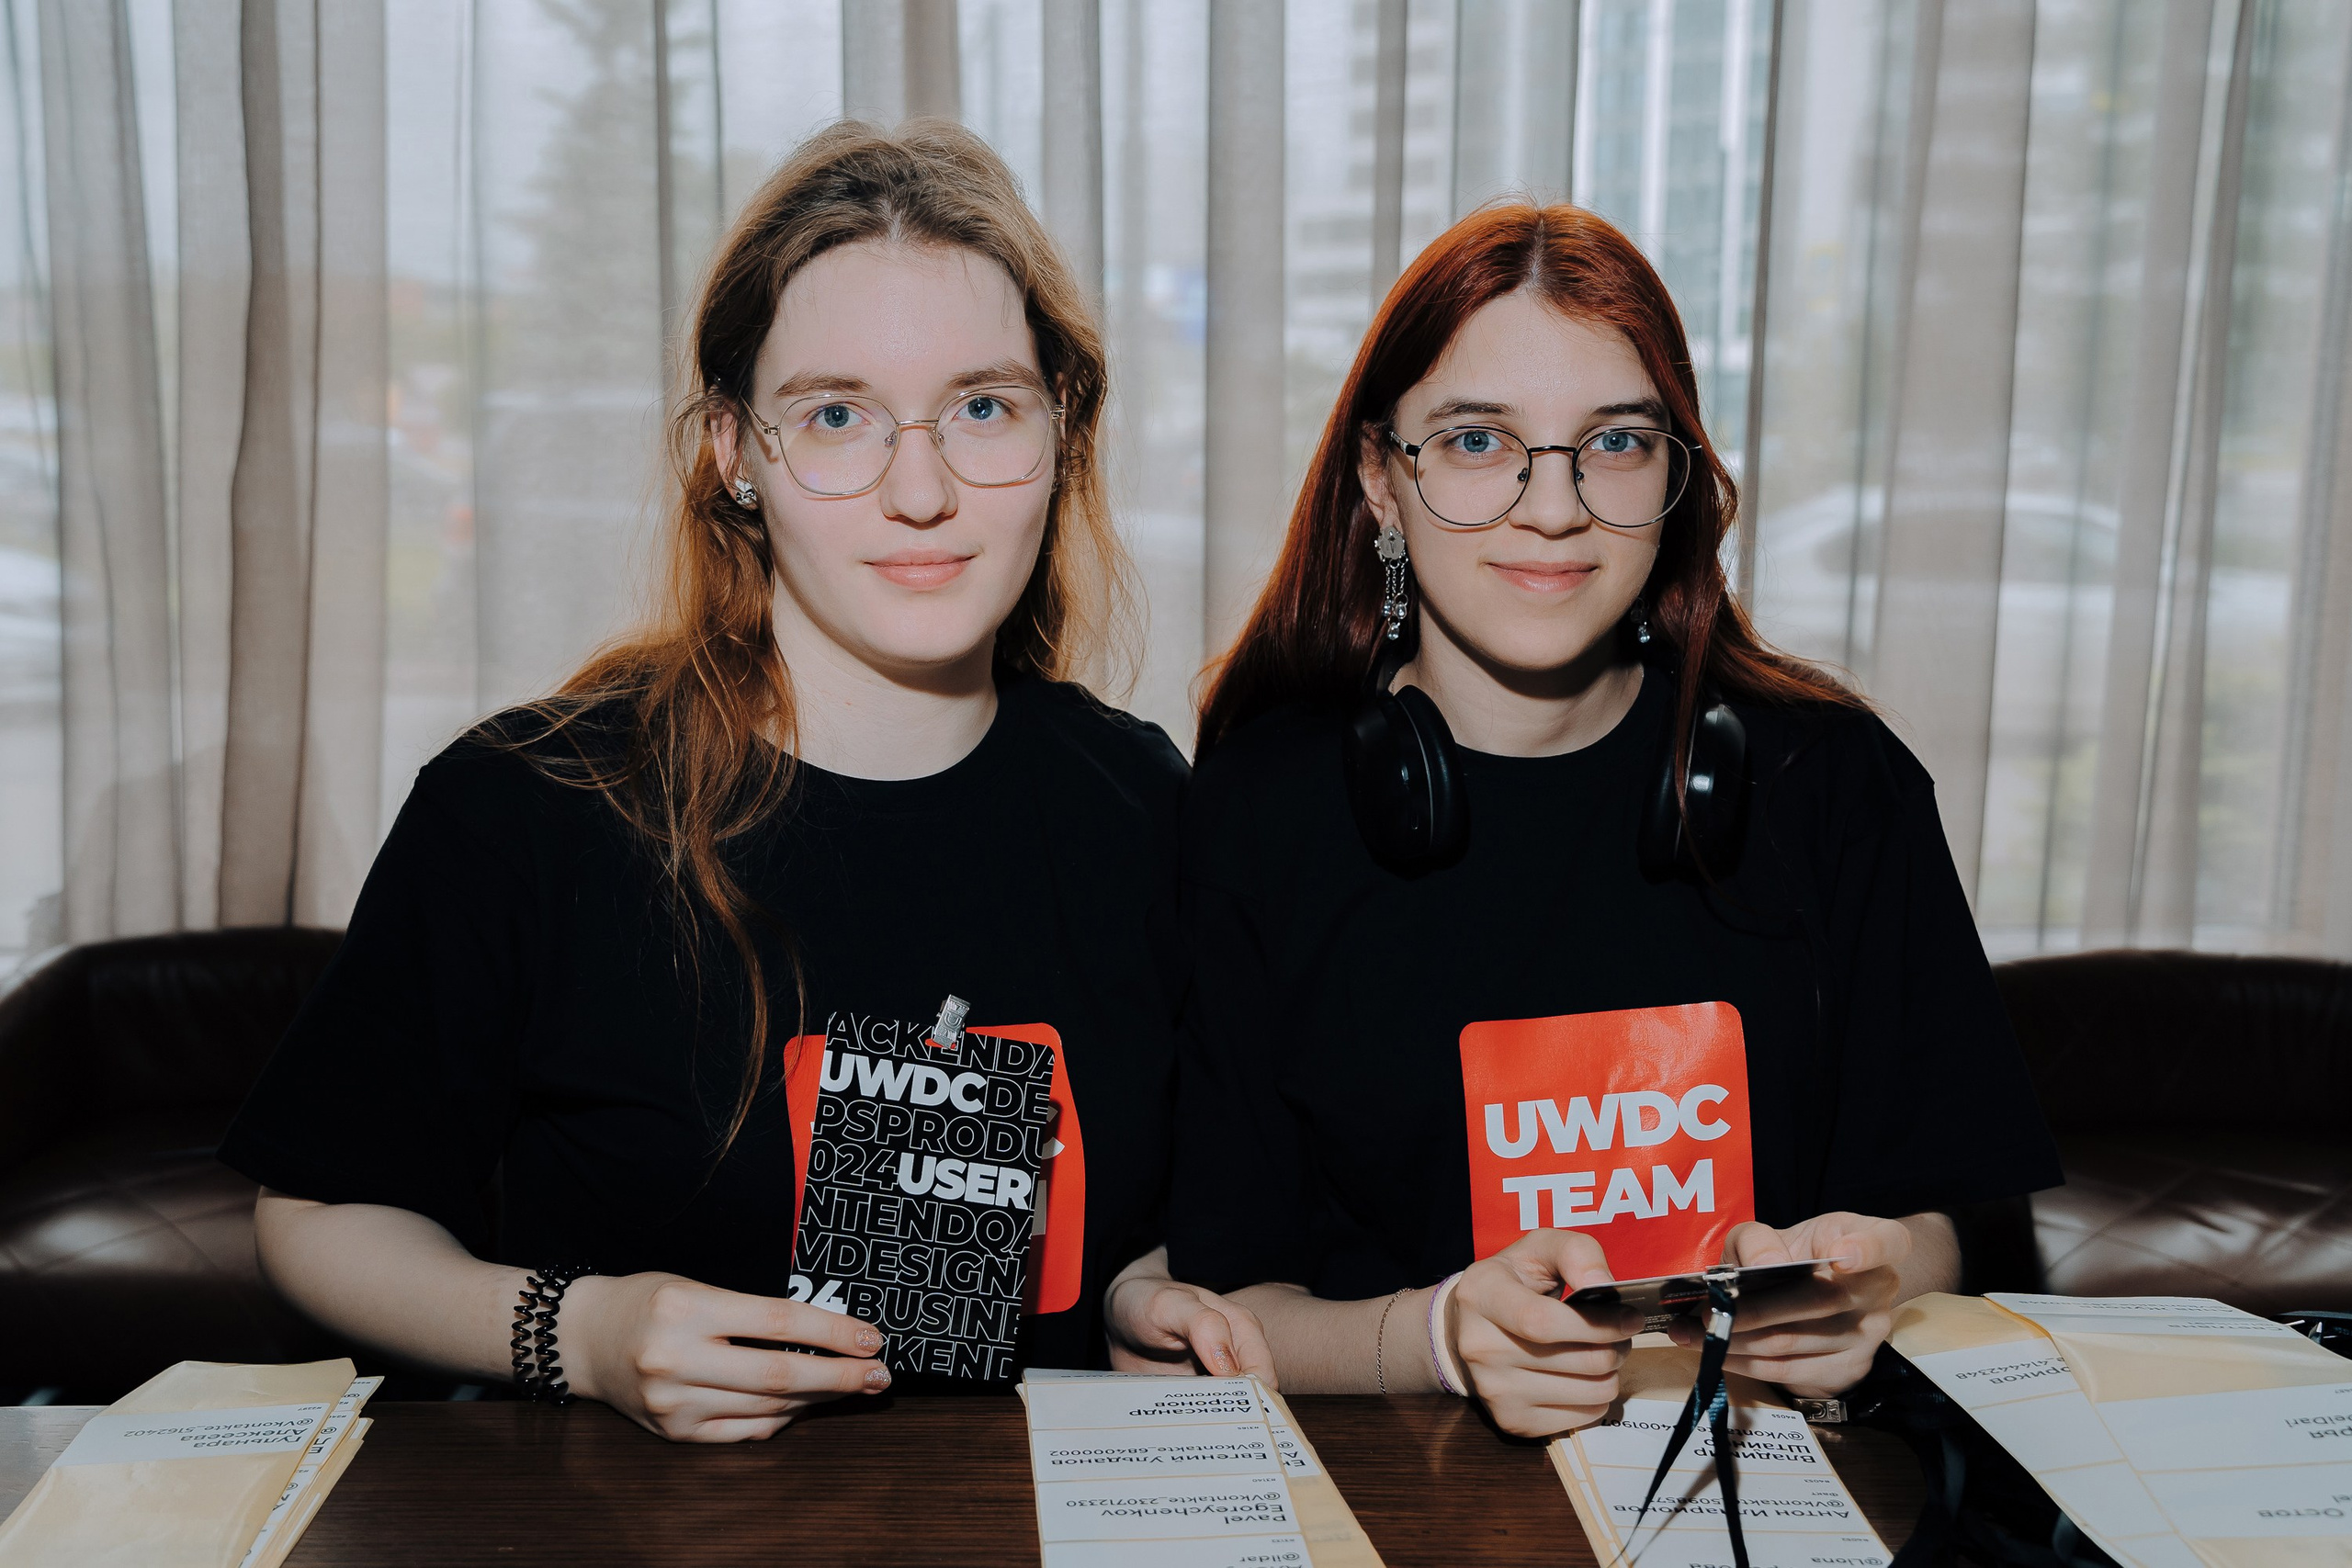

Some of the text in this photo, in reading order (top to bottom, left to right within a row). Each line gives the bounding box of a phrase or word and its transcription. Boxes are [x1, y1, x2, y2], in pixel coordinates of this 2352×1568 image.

[1484, 1084, 1731, 1159] UWDC
[1502, 1158, 1715, 1231] TEAM
[794, 1229, 1026, 1299] VDESIGN
[1154, 1398, 1250, 1408] Воронов
[1128, 1405, 1251, 1417] Александр
[180, 1428, 308, 1441] Алексеева
[193, 1436, 302, 1449] Гульнара
[1050, 1452, 1268, 1466] Евгений Ульданов
[1101, 1503, 1283, 1517] Egoreychenkov
[1775, 1508, 1849, 1518] Антон
[1223, 1514, 1286, 1525] Pavel
